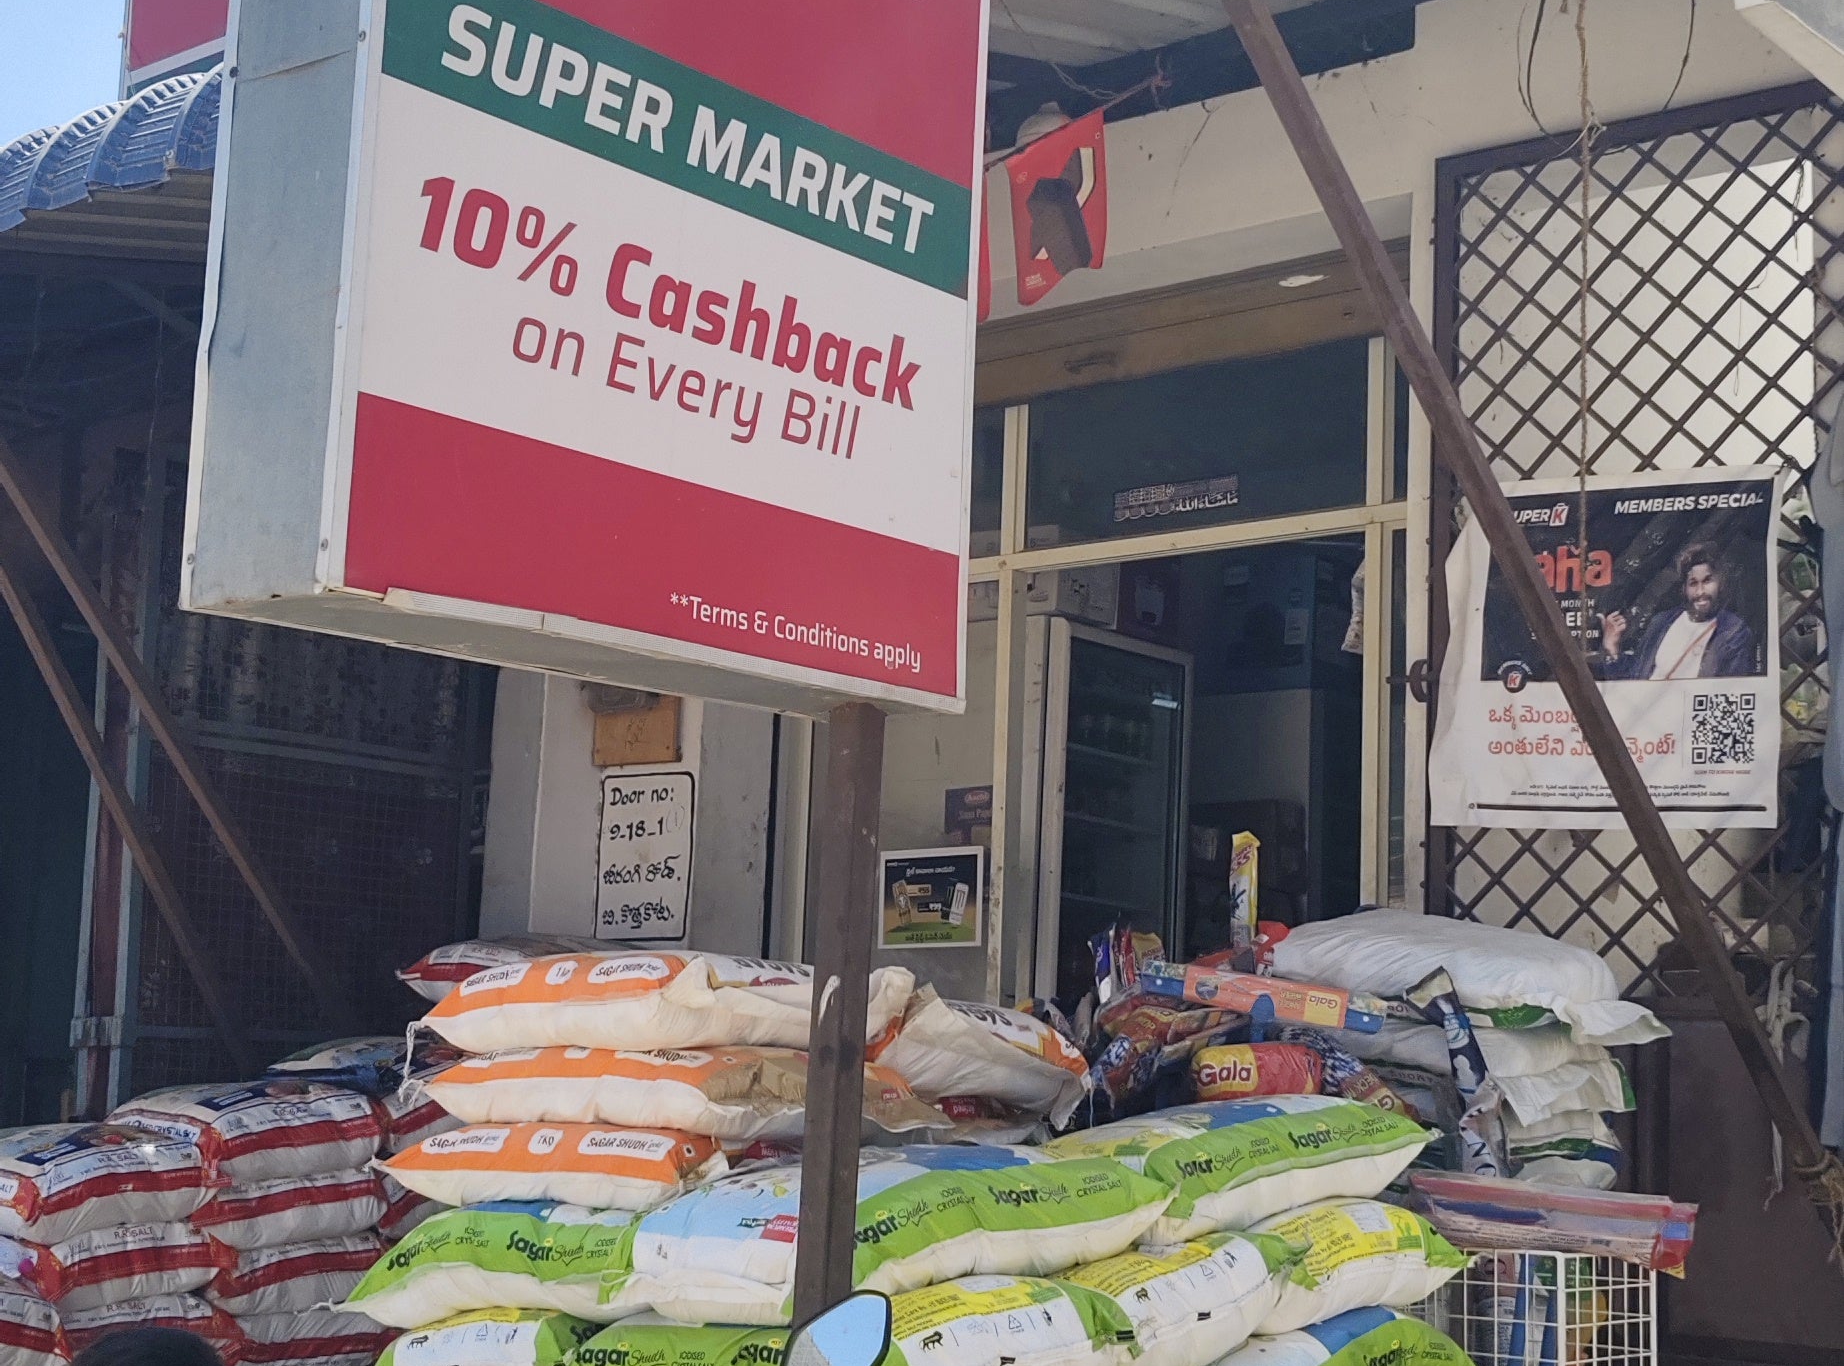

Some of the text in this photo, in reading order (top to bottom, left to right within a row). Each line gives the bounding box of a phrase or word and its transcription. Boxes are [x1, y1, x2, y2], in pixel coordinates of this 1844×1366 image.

[440, 3, 935, 254] SUPER MARKET
[418, 175, 921, 411] 10% Cashback
[512, 315, 860, 460] on Every Bill
[1614, 491, 1764, 515] MEMBERS SPECIAL
[1561, 599, 1595, 608] MONH
[753, 610, 768, 635] &
[773, 614, 869, 656] Conditions
[873, 639, 921, 675] apply
[1488, 704, 1517, 730] ఒక్క
[1488, 734, 1565, 756] అంతులేని
[610, 787, 675, 806] Door no:
[1199, 1060, 1252, 1086] Gala
[587, 1136, 647, 1150] SAGAR SHUDH
[1288, 1126, 1332, 1149] Sagar
[1213, 1146, 1245, 1173] Shudh
[988, 1185, 1039, 1207] Sagar
[1076, 1183, 1107, 1198] CRYSTAL
[898, 1199, 932, 1227] Shudh
[506, 1230, 553, 1262] Sagar
